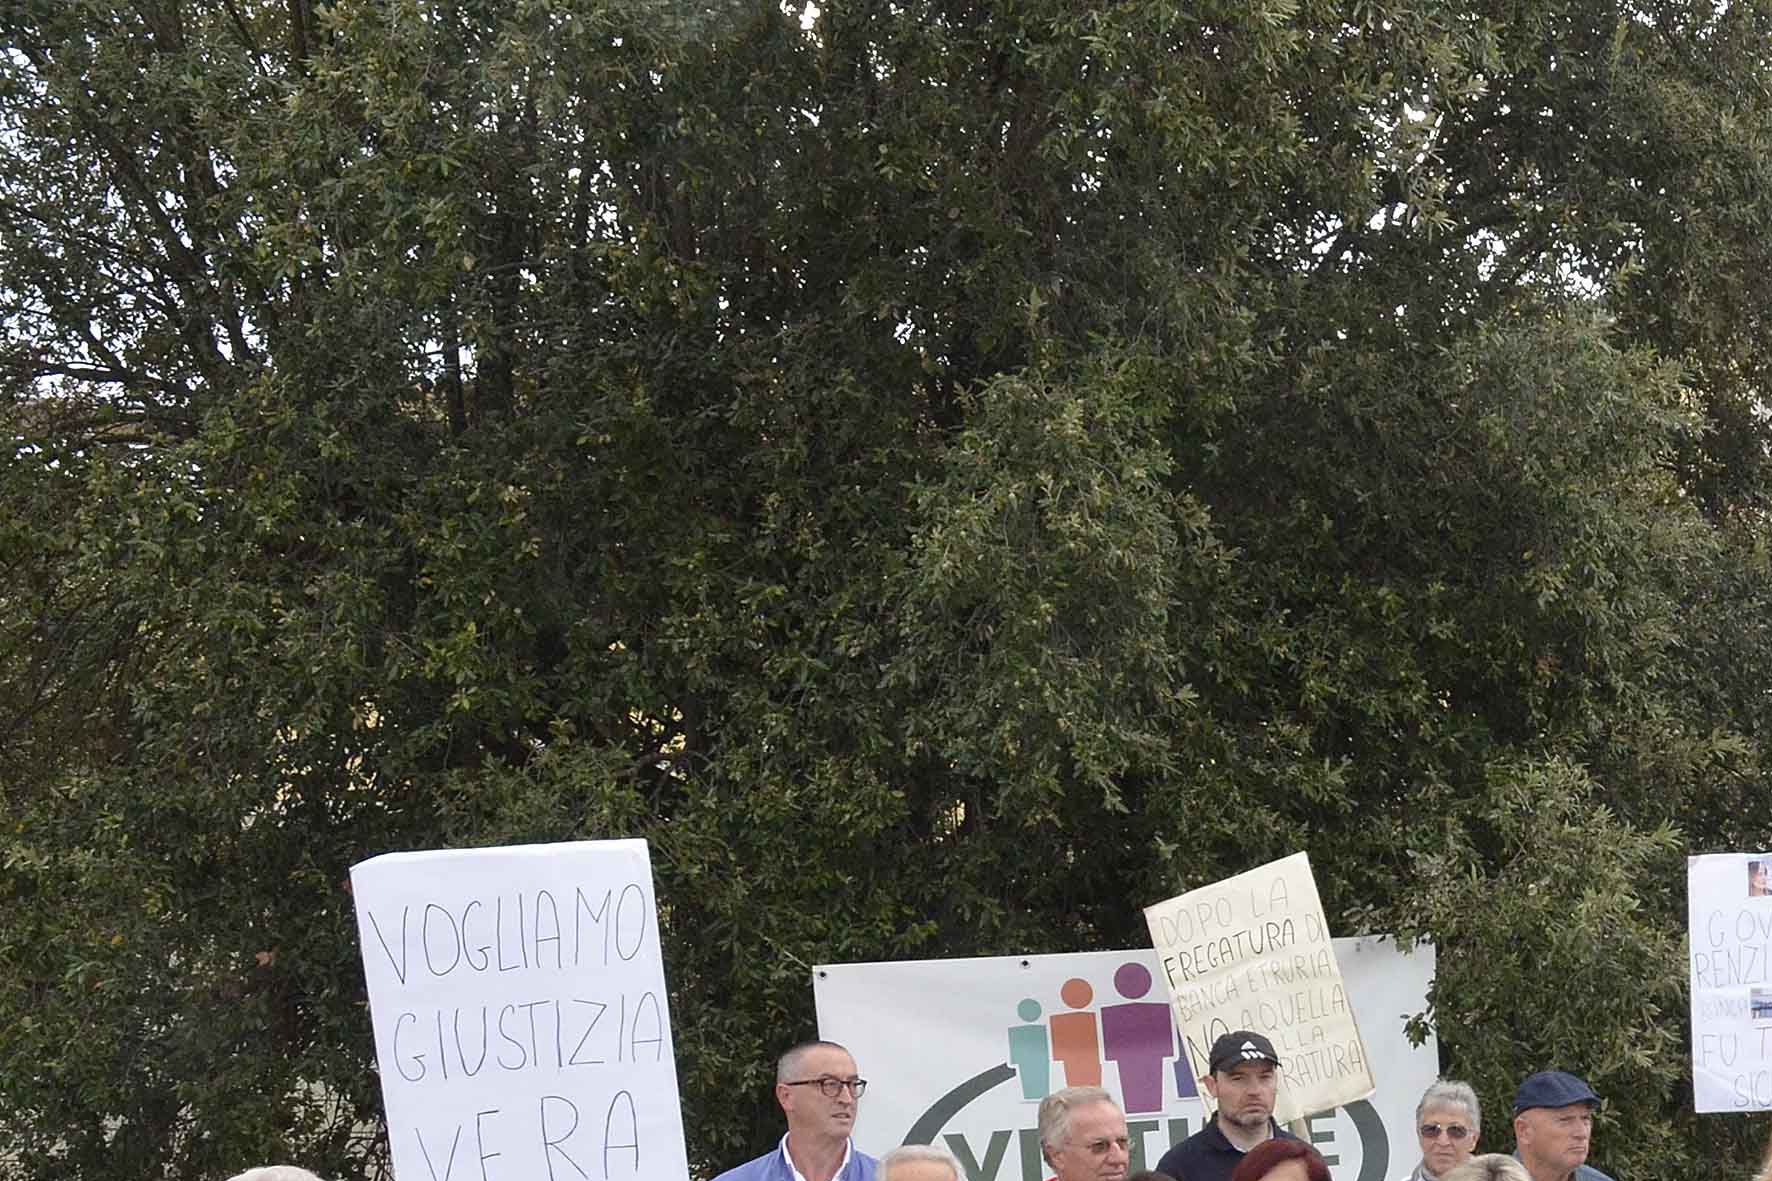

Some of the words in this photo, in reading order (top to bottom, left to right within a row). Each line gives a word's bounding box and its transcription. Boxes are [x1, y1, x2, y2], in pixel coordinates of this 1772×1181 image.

[367, 884, 646, 984] VOGLIAMO
[1160, 897, 1233, 947] DOPO
[1250, 876, 1289, 919] LA
[1163, 918, 1296, 990] FREGATURA
[1304, 911, 1326, 943] DI
[1176, 975, 1240, 1022] BANCA
[1247, 948, 1332, 992] ETRURIA
[1694, 945, 1768, 989] RENZI
[393, 991, 664, 1082] GIUSTIZIA
[1280, 1025, 1325, 1051] LLA
[1700, 1033, 1737, 1067] FU
